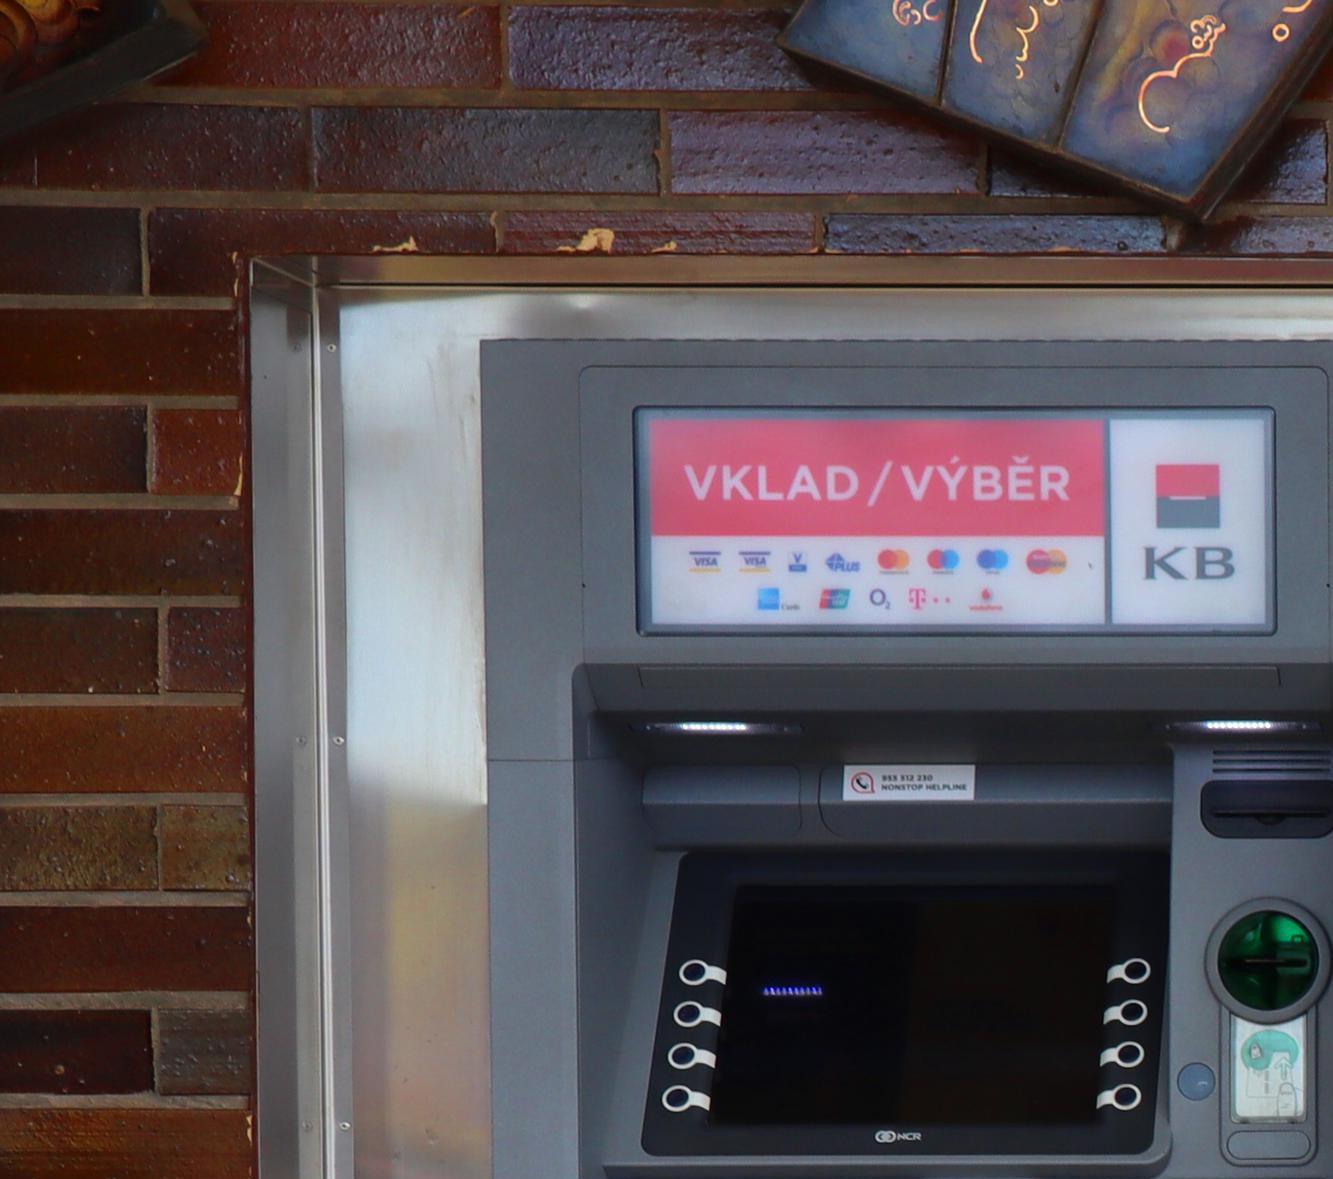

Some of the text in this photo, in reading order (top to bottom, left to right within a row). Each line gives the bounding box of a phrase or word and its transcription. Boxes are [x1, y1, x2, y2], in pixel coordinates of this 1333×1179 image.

[694, 557, 718, 567] VISA
[744, 557, 767, 566] VISA
[1143, 546, 1236, 581] KB
[833, 561, 861, 572] PLUS
[881, 783, 967, 791] NONSTOP HELPLINE
[897, 1132, 922, 1141] NCR
